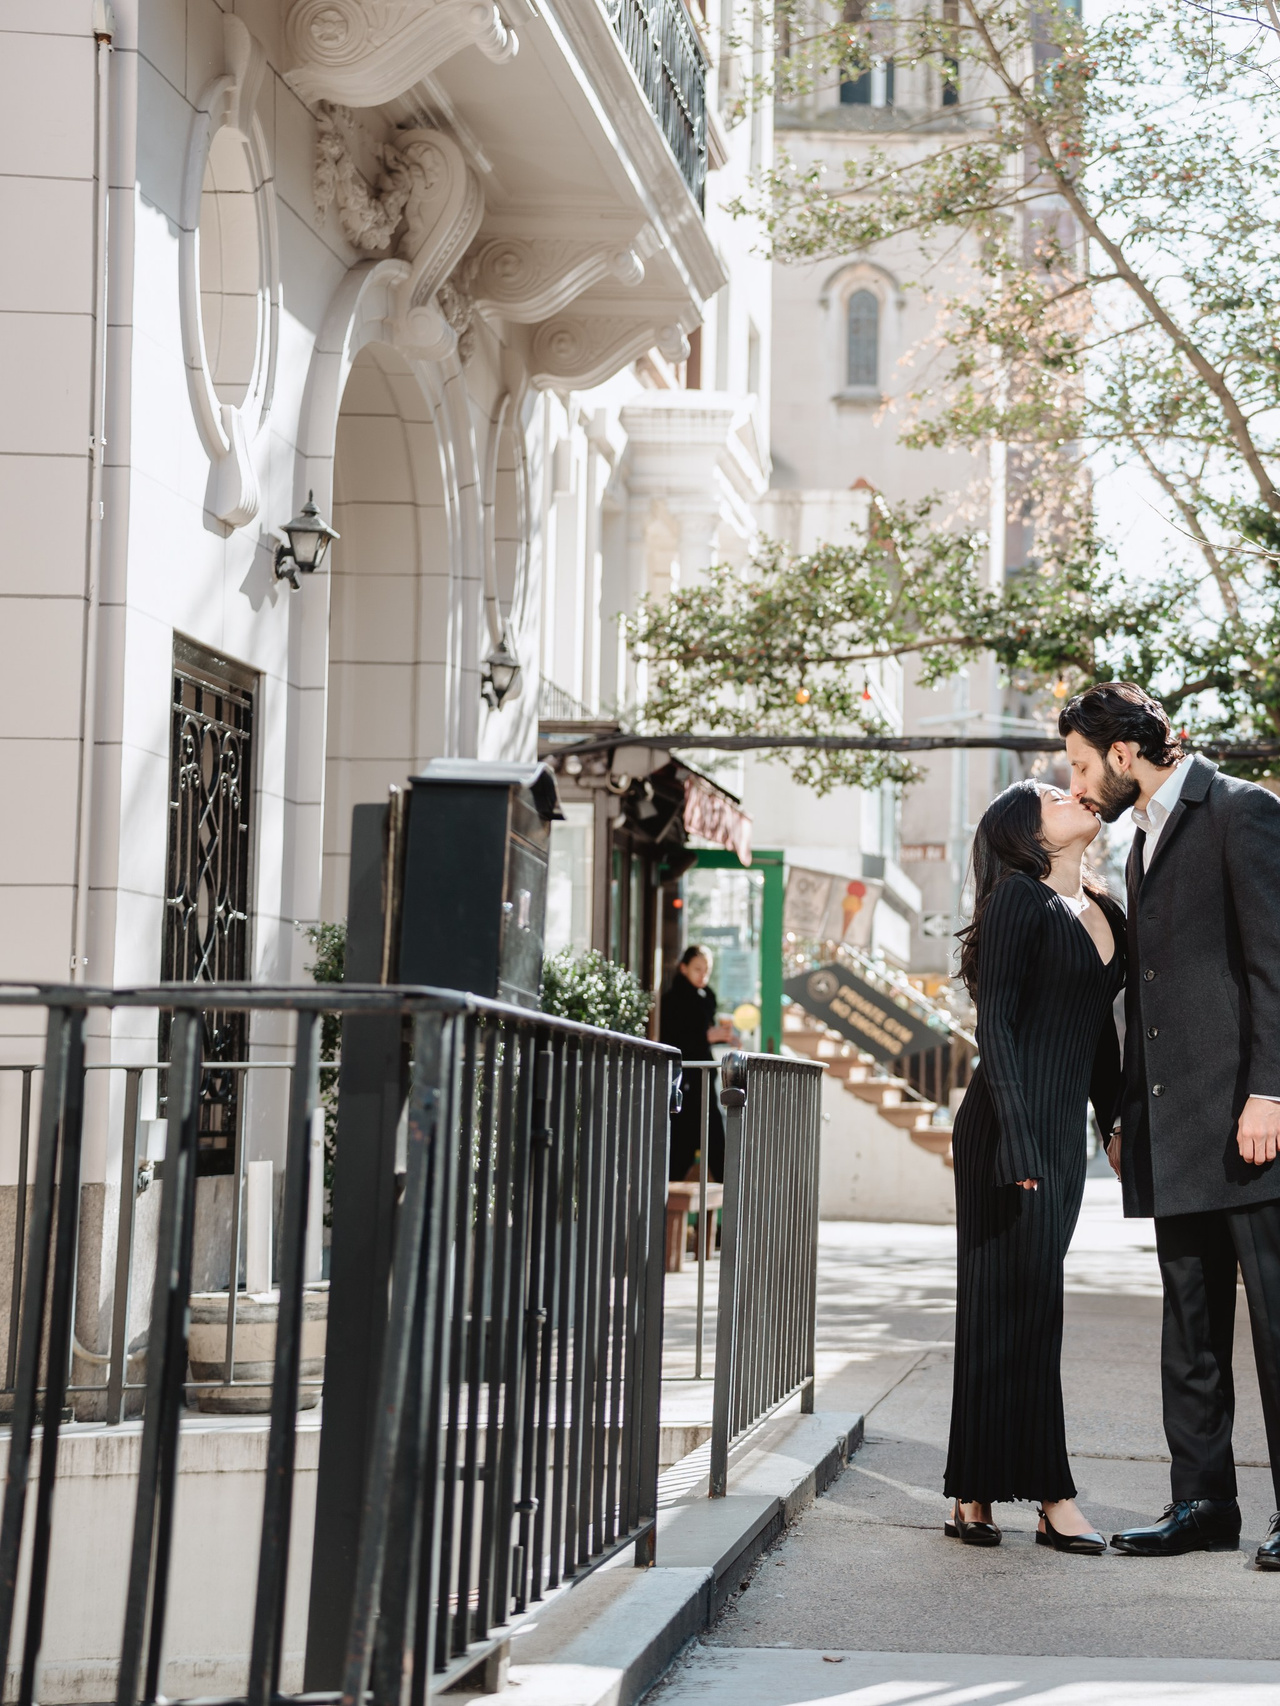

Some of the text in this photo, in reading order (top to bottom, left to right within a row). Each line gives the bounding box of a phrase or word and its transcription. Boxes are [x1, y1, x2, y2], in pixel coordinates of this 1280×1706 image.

[829, 998, 904, 1056] NO SMOKING
[837, 985, 914, 1045] PRIVATE GYM
